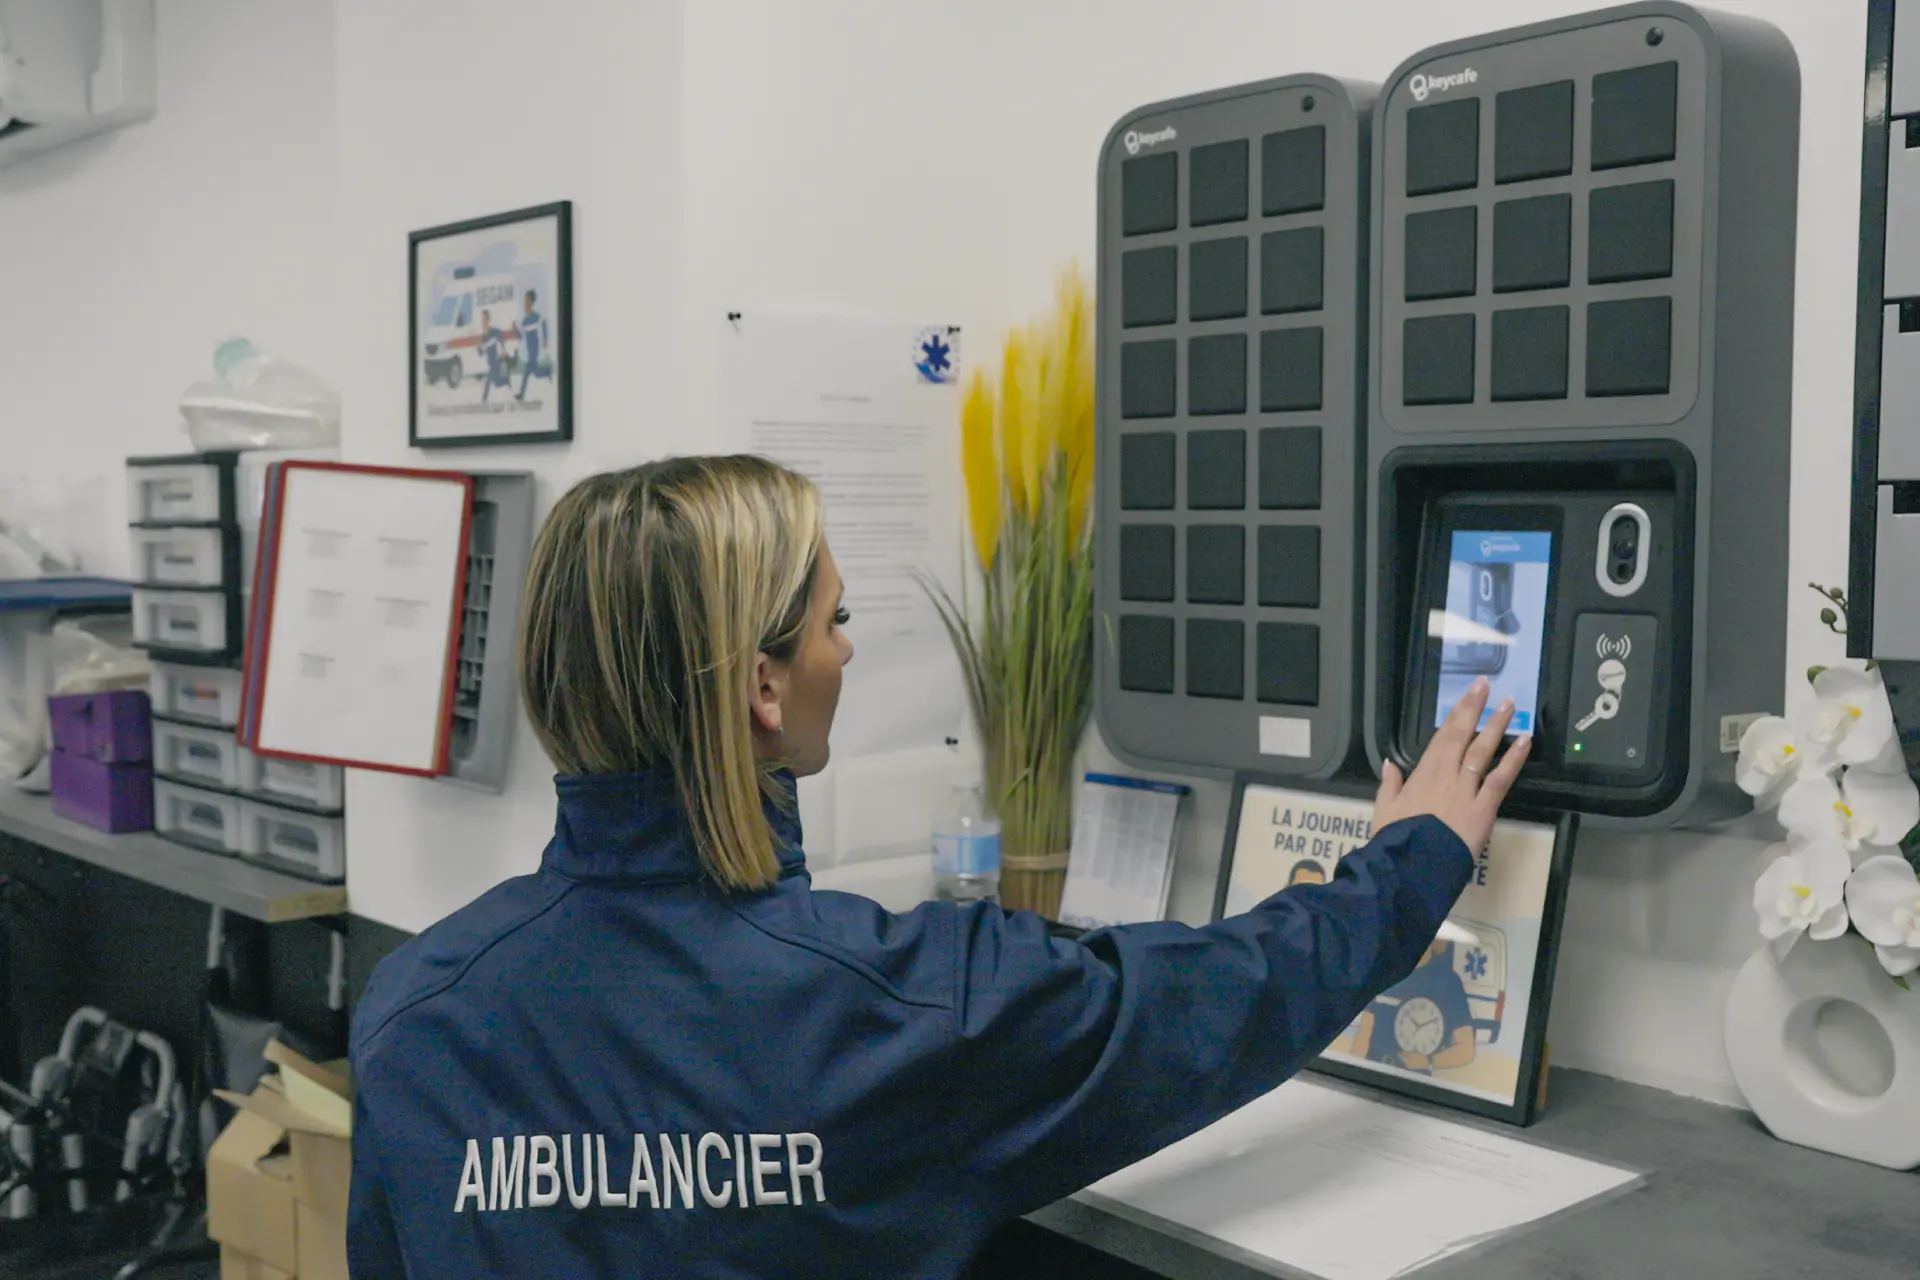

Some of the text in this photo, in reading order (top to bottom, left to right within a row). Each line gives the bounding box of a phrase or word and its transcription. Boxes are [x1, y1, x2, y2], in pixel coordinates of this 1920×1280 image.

[1428, 67, 1478, 91] keycafe
[1272, 806, 1292, 827] LA
[1274, 832, 1306, 854] PAR
[1311, 838, 1333, 858] DE
[454, 1132, 826, 1213] AMBULANCIER
